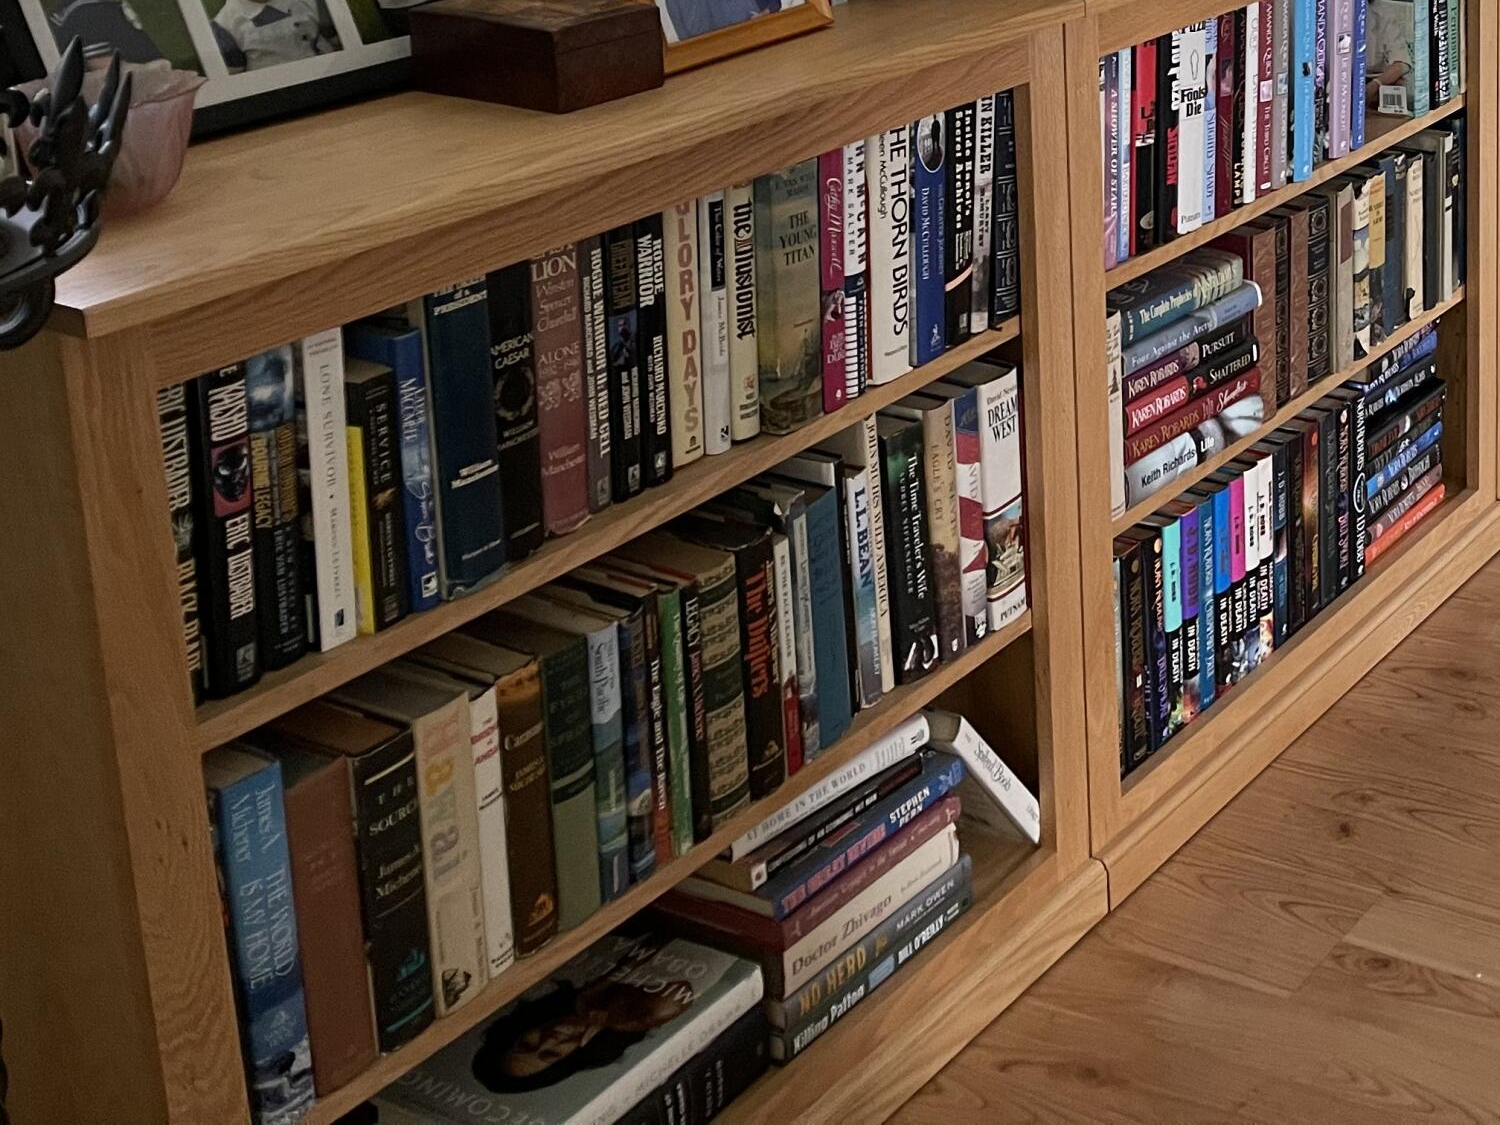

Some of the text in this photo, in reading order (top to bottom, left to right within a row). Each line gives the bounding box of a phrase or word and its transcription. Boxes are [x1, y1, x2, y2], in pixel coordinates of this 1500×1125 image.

[1186, 101, 1202, 118] Die
[530, 251, 578, 283] LION
[890, 166, 909, 337] THORN BIRDS
[1131, 351, 1150, 367] Four
[1202, 331, 1236, 358] PURSUIT
[682, 328, 699, 433] DAYS
[1209, 352, 1251, 385] SHATTERED
[319, 363, 338, 488] LONE SURVIVOR
[987, 394, 1018, 427] DREAM
[991, 414, 1017, 444] WEST
[907, 454, 918, 479] The
[1141, 466, 1161, 489] Keith
[1162, 448, 1196, 477] Richards
[909, 479, 920, 512] Time
[917, 566, 927, 600] Wife
[889, 786, 931, 825] STEPHEN
[895, 904, 925, 931] MARK
[924, 878, 955, 906] OWEN
[791, 894, 893, 977] Doctor Zhivago
[792, 1013, 830, 1056] Killing
[829, 983, 866, 1024] Patton
